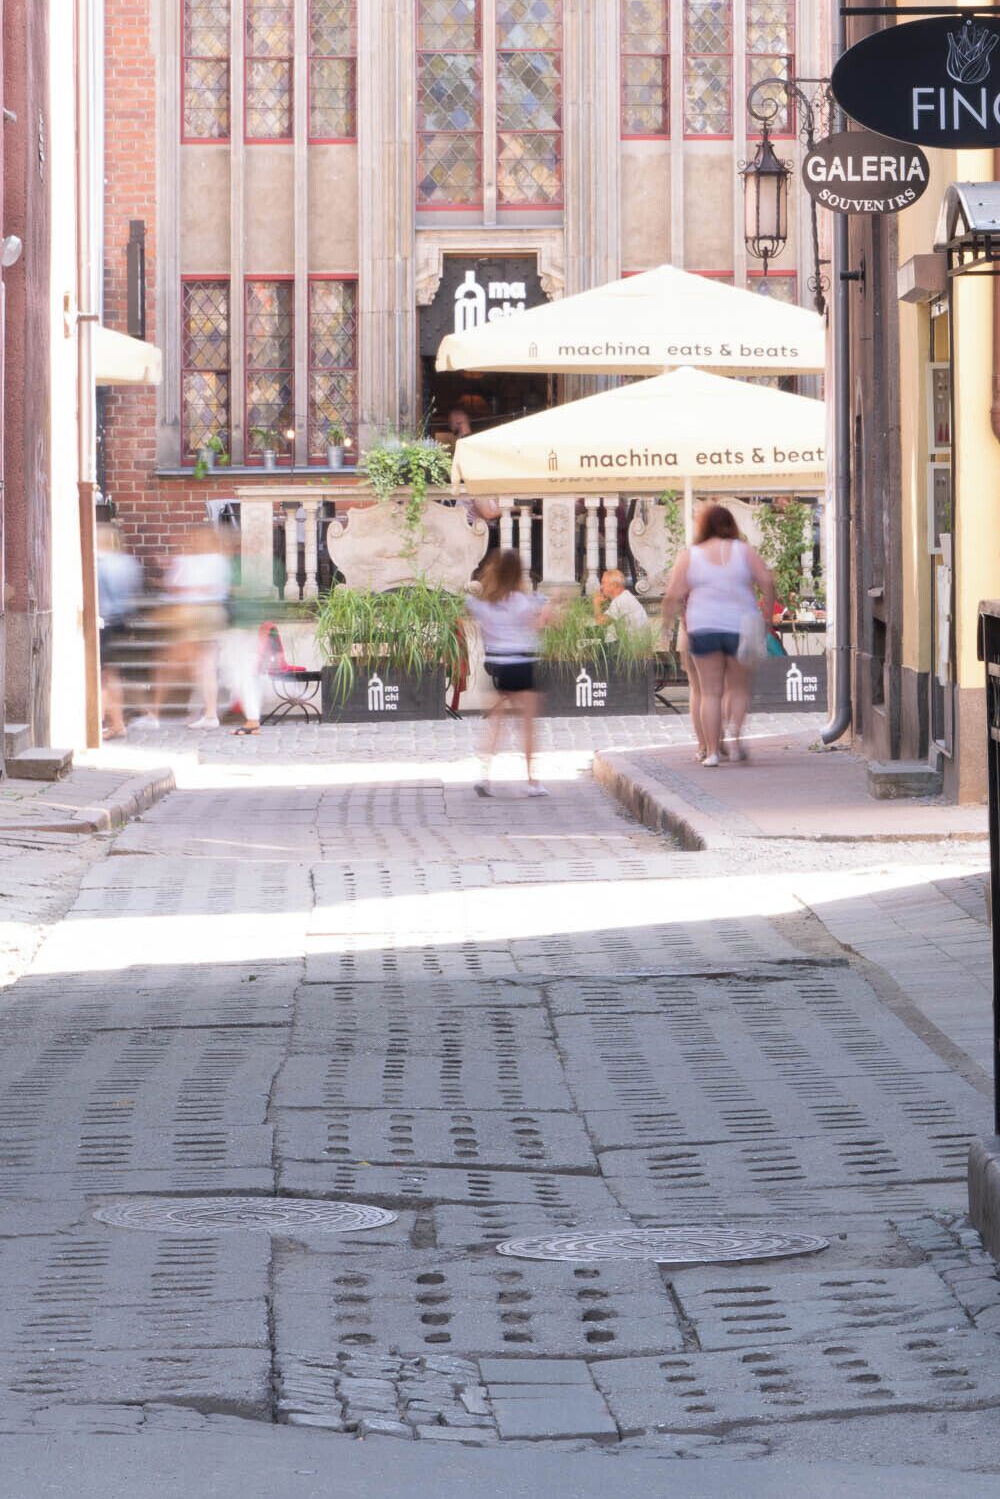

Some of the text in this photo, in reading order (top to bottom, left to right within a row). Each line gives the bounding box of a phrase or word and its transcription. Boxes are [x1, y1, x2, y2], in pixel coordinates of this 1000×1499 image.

[806, 155, 926, 182] GALERIA
[818, 187, 917, 212] SOUVENIRS
[488, 282, 527, 299] ma
[558, 341, 800, 358] machina eats & beats
[579, 446, 825, 469] machina eats & beat
